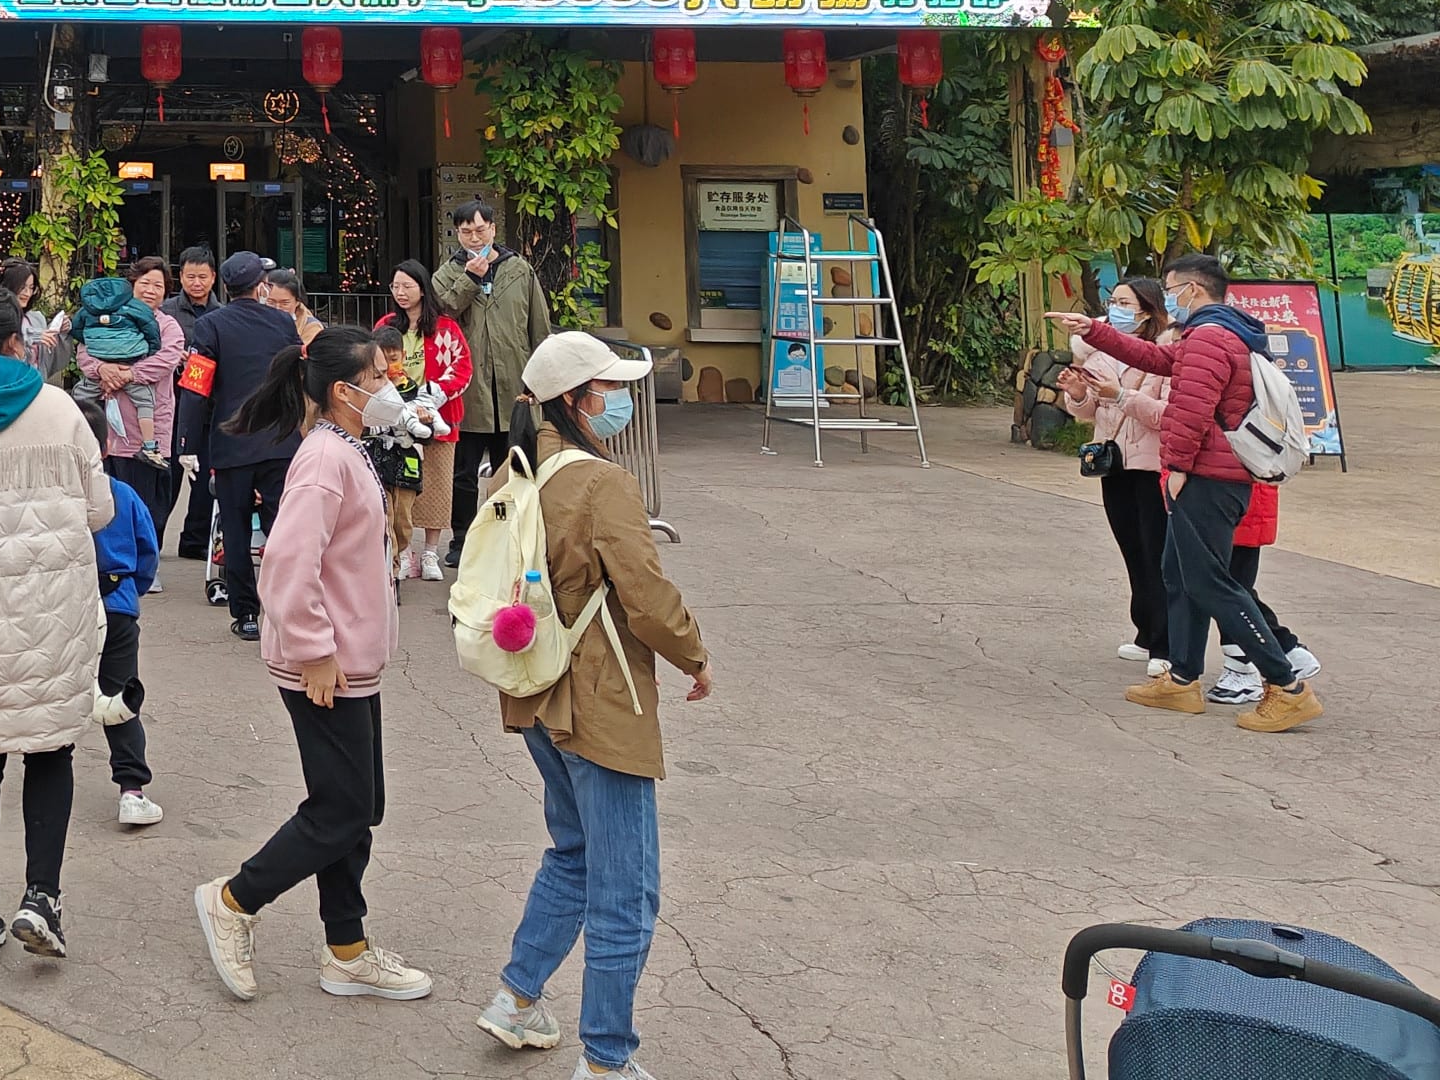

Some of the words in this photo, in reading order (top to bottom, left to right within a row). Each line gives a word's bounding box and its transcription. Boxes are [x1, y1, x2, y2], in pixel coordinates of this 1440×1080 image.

[707, 191, 769, 204] 贮存服务处
[1110, 983, 1128, 1006] gb
